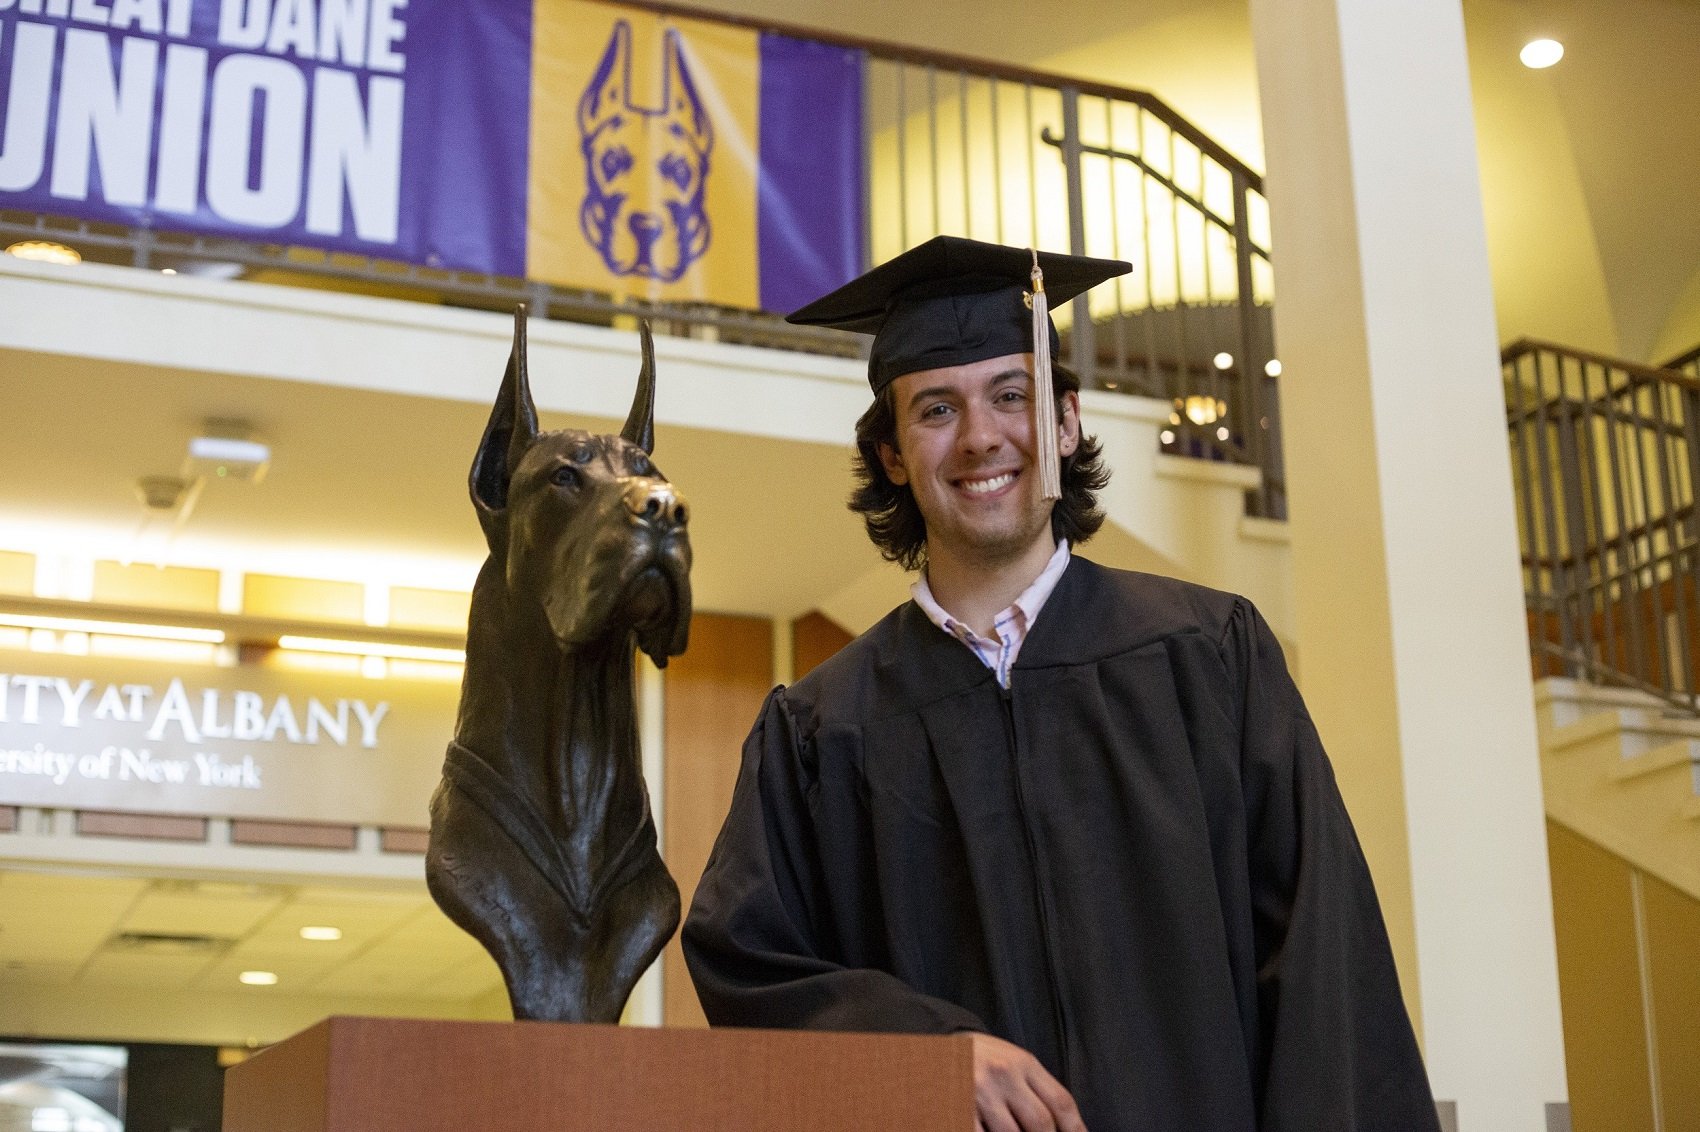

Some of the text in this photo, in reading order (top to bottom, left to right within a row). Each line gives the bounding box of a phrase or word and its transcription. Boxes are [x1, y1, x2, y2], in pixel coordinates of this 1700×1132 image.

[217, 0, 407, 73] DANE
[94, 683, 153, 722] AT
[145, 677, 388, 748] ALBANY
[78, 745, 117, 779] of
[118, 747, 190, 784] New
[193, 752, 262, 788] York
